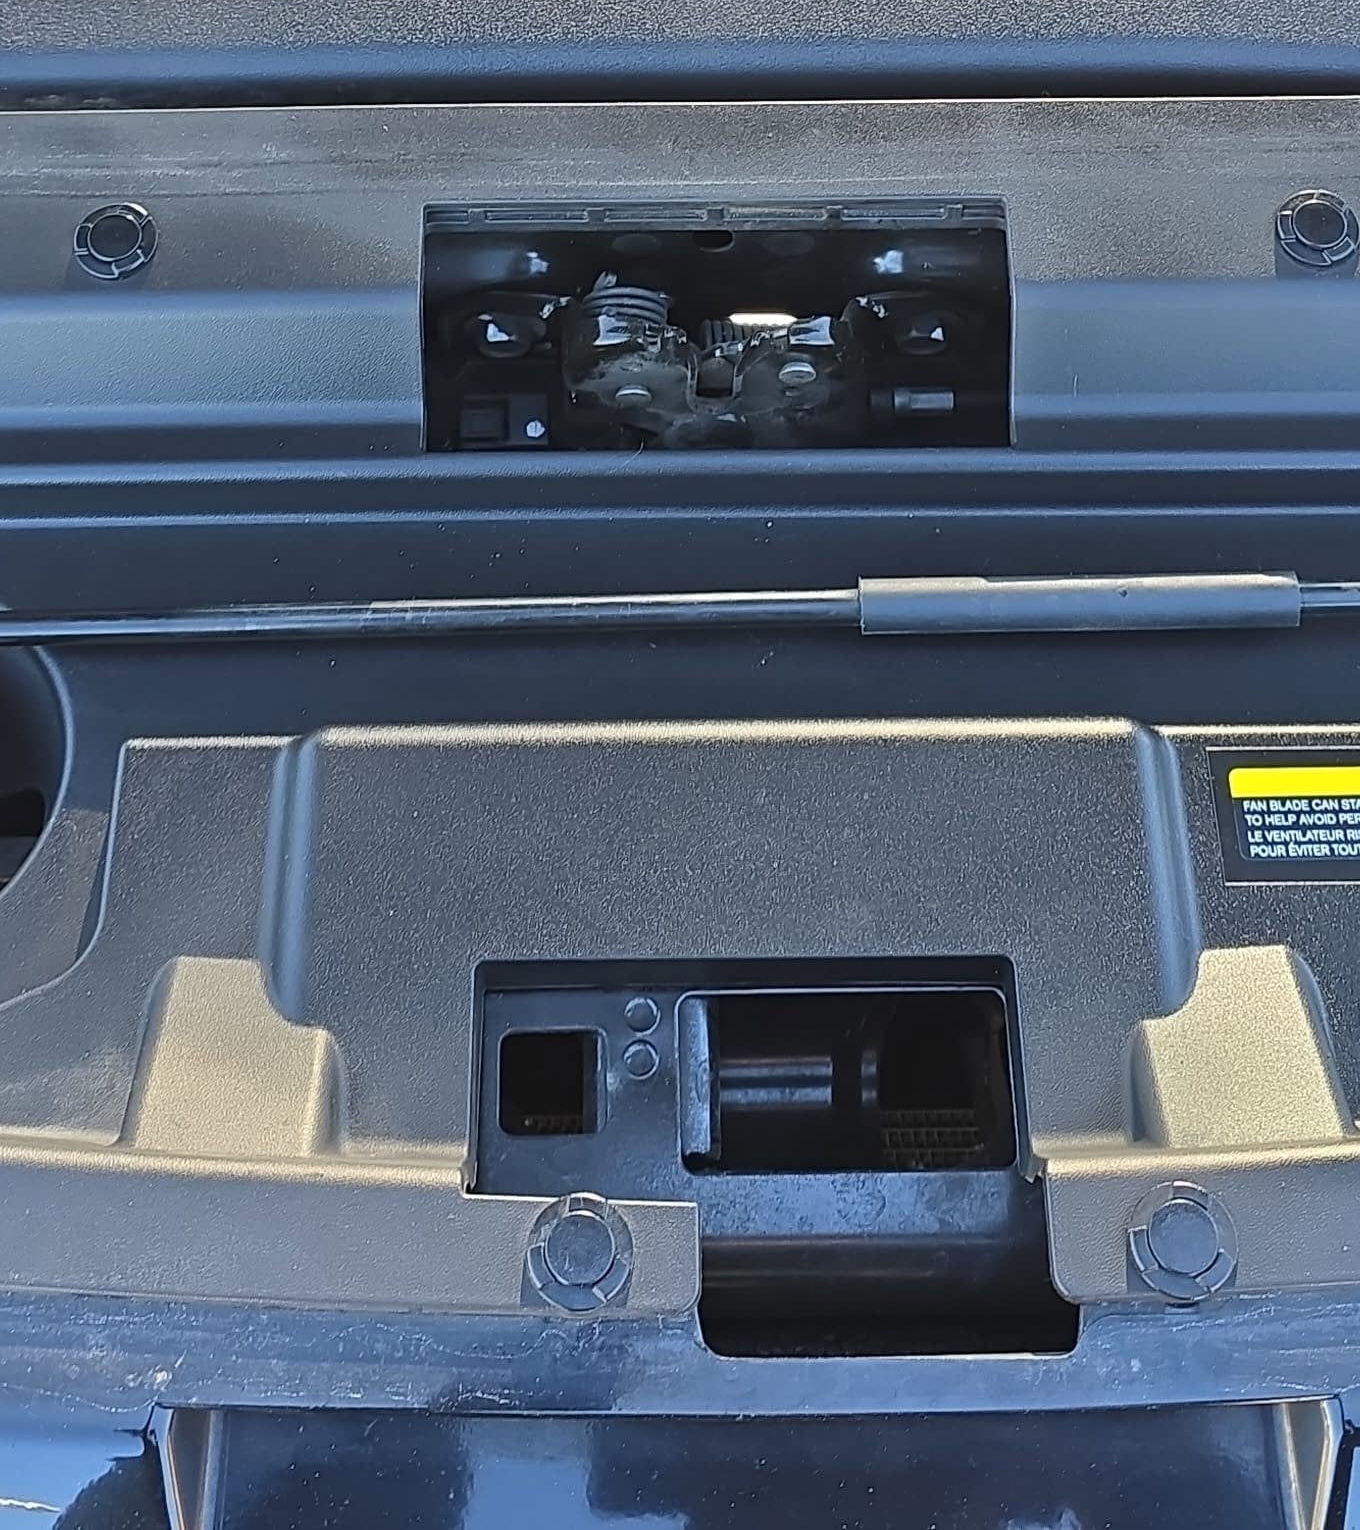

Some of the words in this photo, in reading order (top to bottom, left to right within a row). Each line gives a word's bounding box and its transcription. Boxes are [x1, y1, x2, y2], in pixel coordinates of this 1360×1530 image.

[1243, 800, 1267, 812] FAN
[1269, 799, 1310, 811] BLADE
[1311, 799, 1339, 811] CAN
[1245, 814, 1262, 826] TO
[1264, 814, 1297, 826] HELP
[1298, 813, 1337, 825] AVOID
[1247, 830, 1263, 842] LE
[1264, 829, 1345, 842] VENTILATEUR
[1250, 845, 1287, 857] POUR
[1288, 843, 1331, 857] ÉVITER
